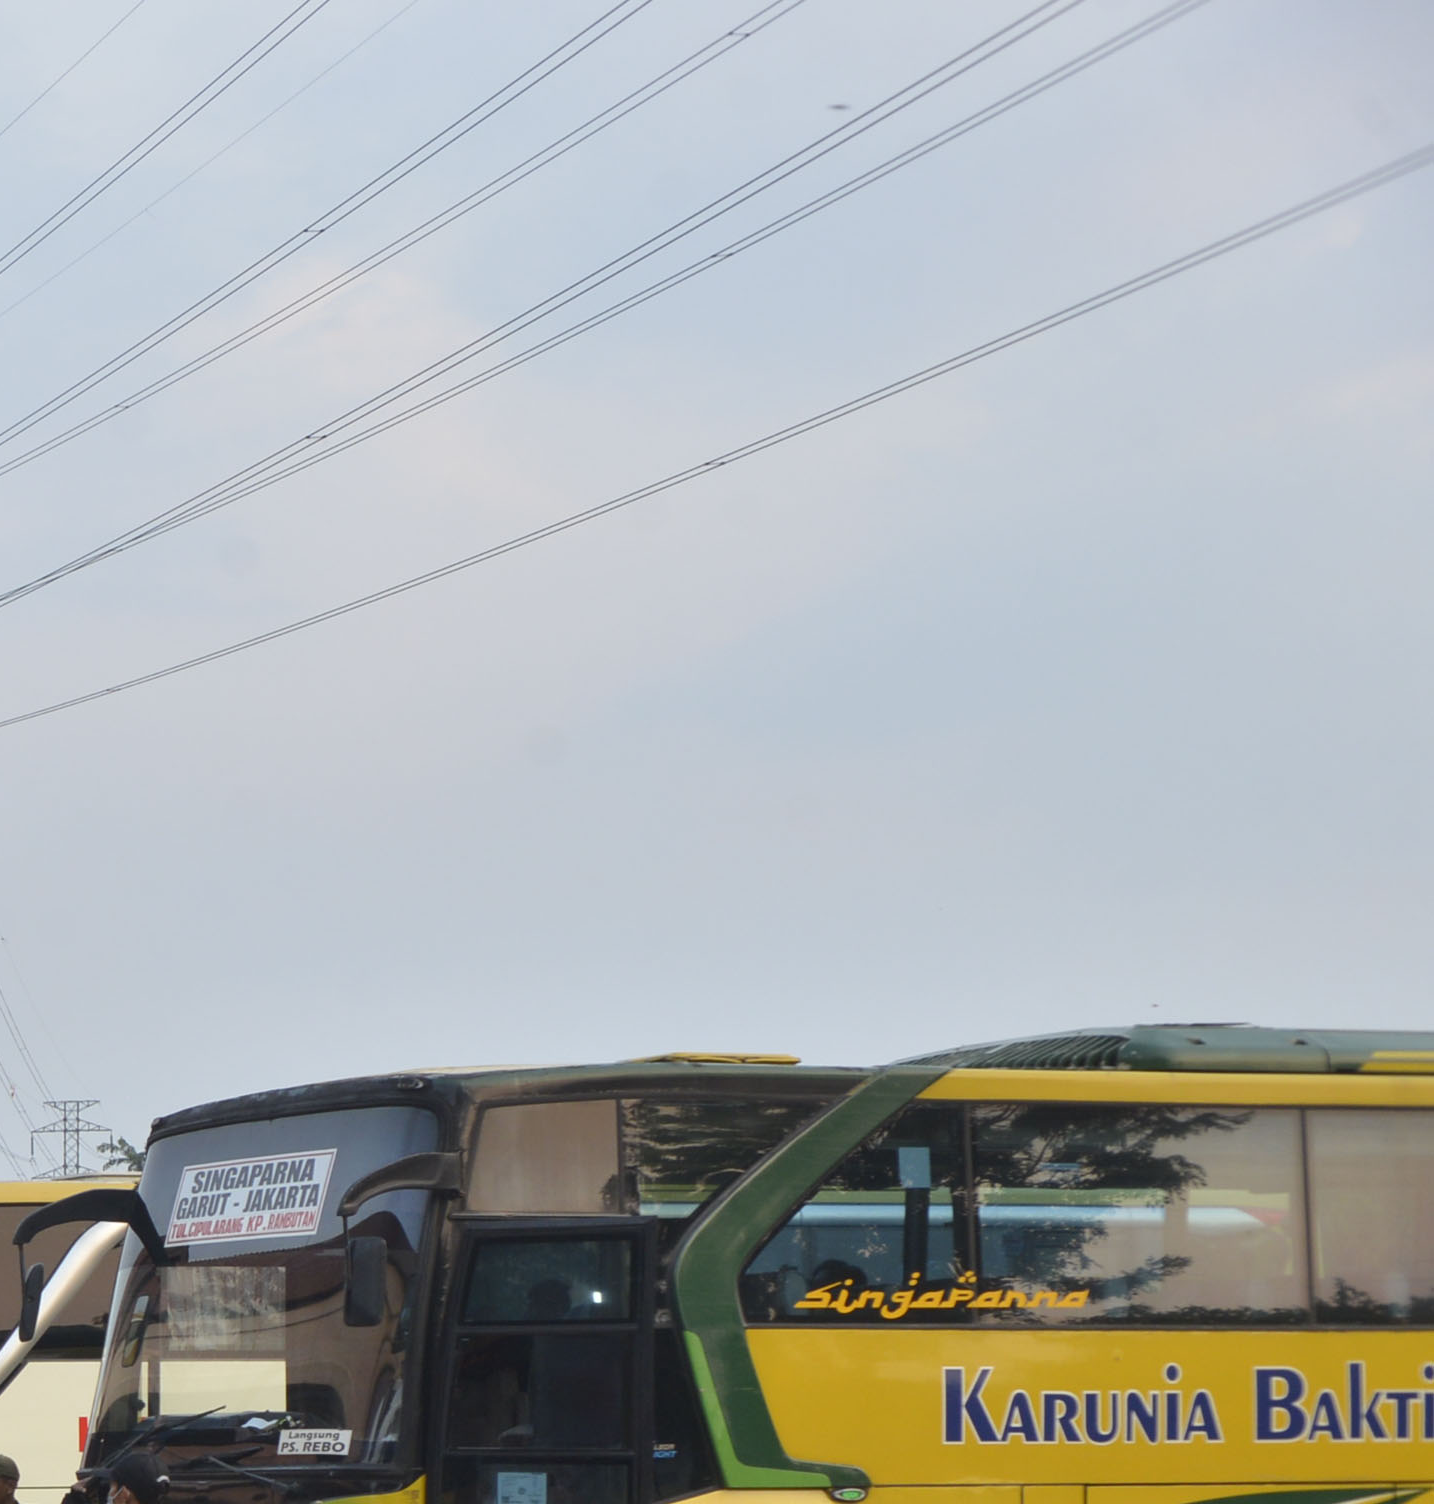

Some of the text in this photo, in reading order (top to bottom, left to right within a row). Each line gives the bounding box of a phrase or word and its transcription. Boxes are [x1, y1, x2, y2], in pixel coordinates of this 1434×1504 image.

[191, 1158, 316, 1194] SINGAPARNA
[176, 1192, 231, 1220] GARUT
[242, 1183, 320, 1213] JAKARTA
[280, 1442, 345, 1452] PS. REBO
[288, 1431, 340, 1440] Langsung
